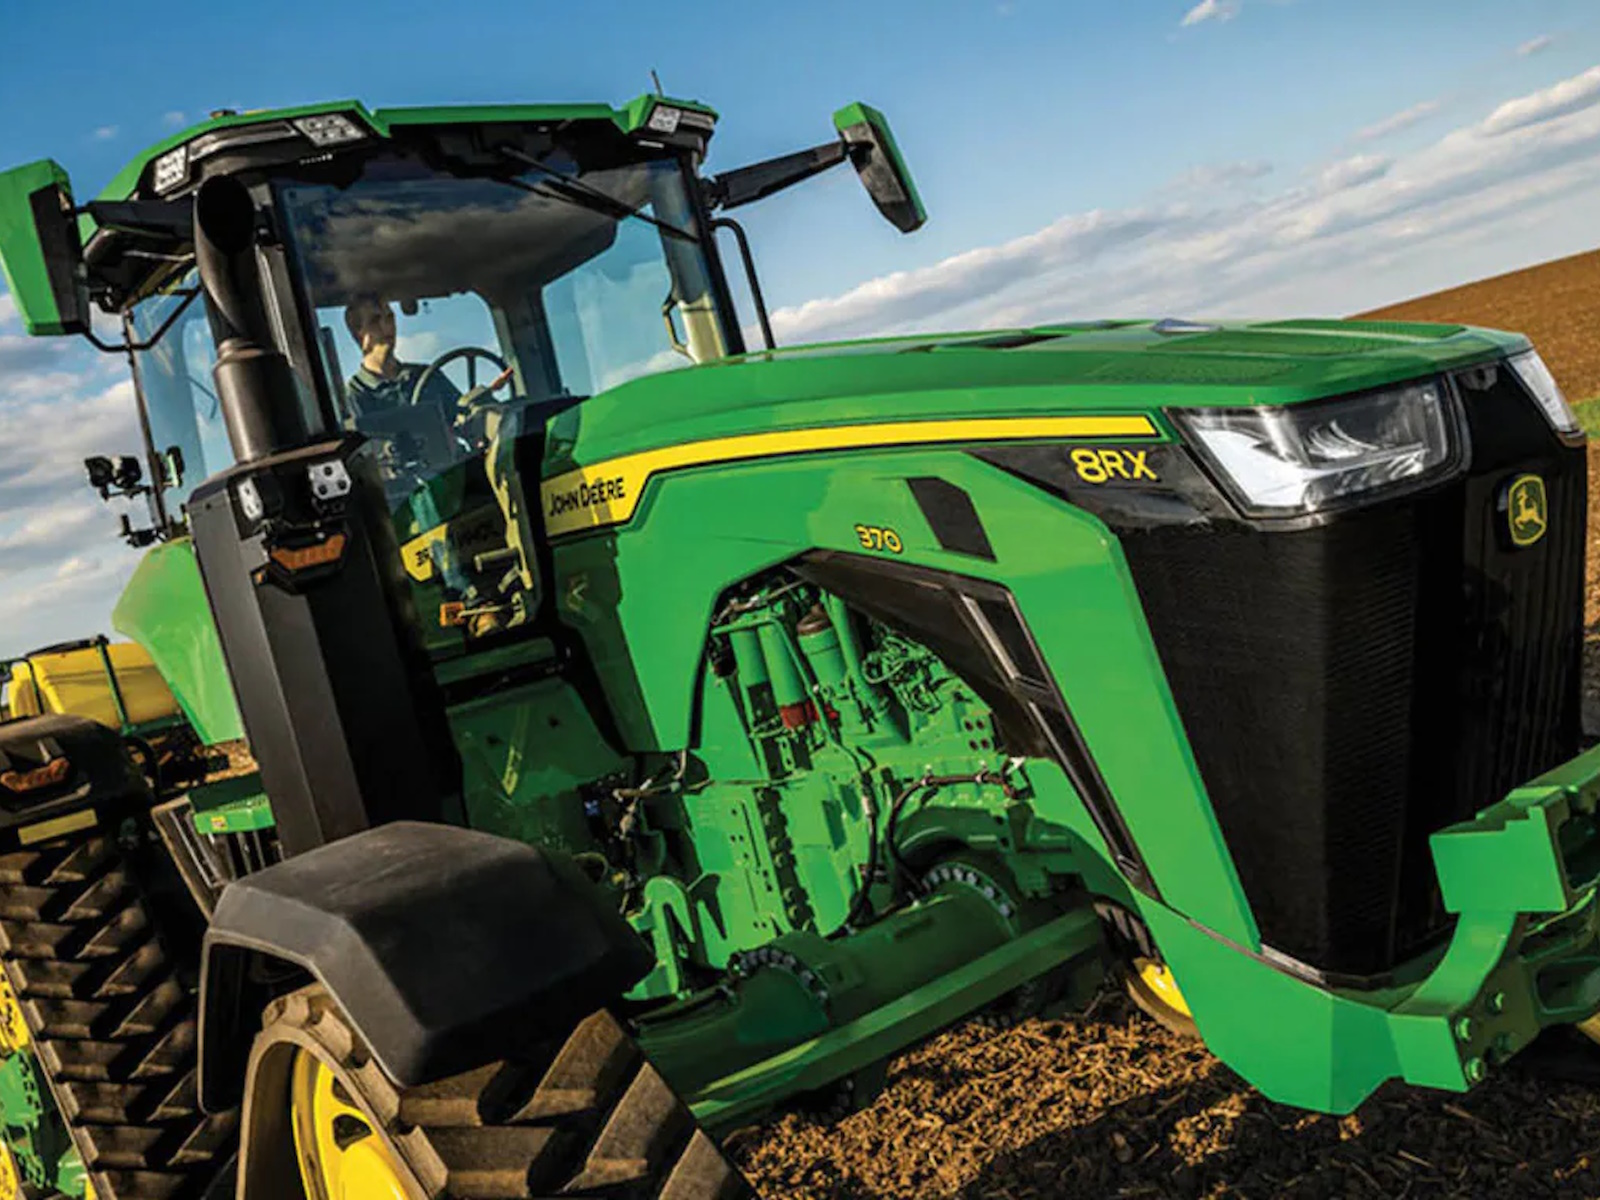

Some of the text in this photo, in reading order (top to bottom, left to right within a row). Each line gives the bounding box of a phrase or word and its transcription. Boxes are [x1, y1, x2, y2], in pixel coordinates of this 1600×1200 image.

[1070, 448, 1158, 483] 8RX
[549, 477, 625, 517] JOHN DEERE
[854, 524, 903, 554] 370
